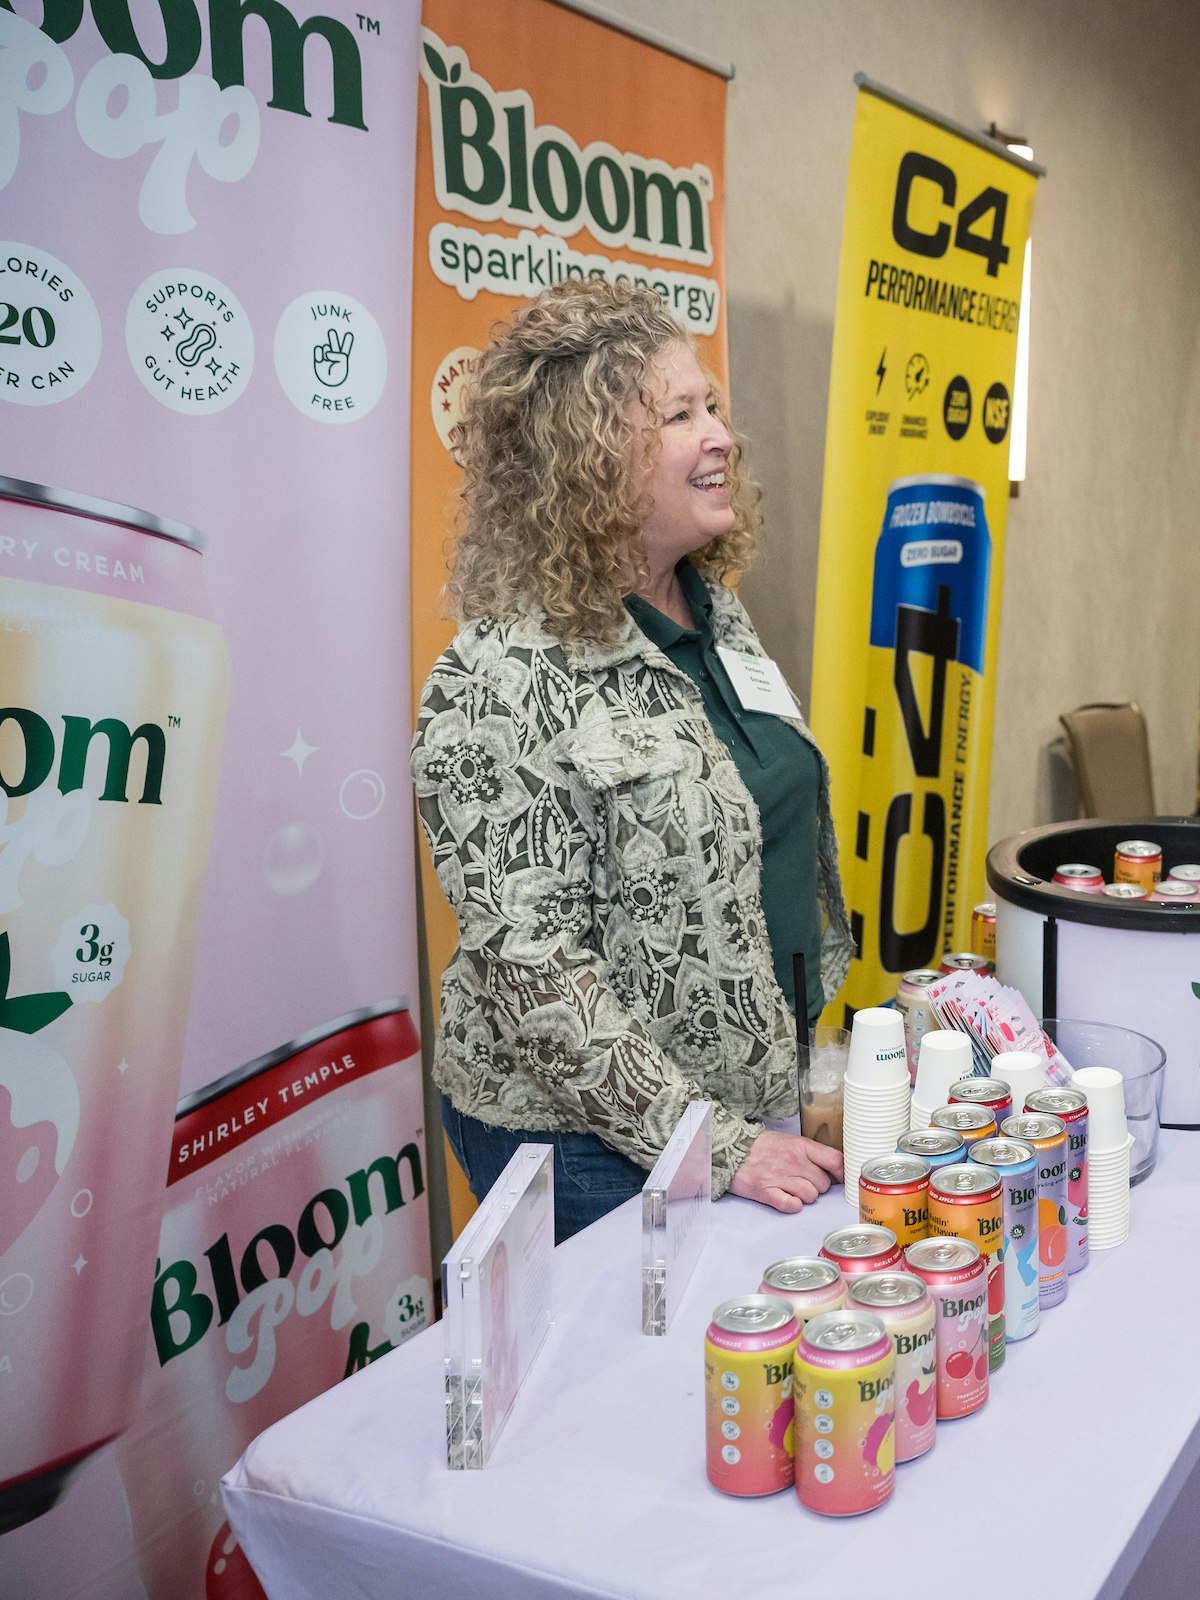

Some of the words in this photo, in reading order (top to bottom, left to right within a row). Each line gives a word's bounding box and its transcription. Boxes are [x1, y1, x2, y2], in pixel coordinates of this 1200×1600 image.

[439, 84, 707, 254] Bloom
[892, 152, 1011, 278] C4
[146, 283, 234, 323] SUPPORTS
[865, 259, 978, 323] PERFORMANCE
[0, 302, 56, 348] 20
[311, 304, 352, 322] JUNK
[31, 360, 75, 390] CAN
[145, 355, 175, 390] GUT
[181, 361, 241, 401] HEALTH
[311, 394, 355, 411] FREE
[53, 547, 146, 584] CREAM
[955, 672, 972, 764] ENERGY
[76, 923, 115, 967] 3g
[71, 971, 111, 983] SUGAR
[178, 1098, 270, 1164] SHIRLEY
[277, 1053, 356, 1104] TEMPLE
[866, 1184, 881, 1193] APPLE
[938, 1196, 954, 1204] APPLE
[150, 1143, 425, 1368] Bloom
[873, 1256, 893, 1268] SHIRLEY
[949, 1272, 971, 1282] SHIRLEY
[398, 1294, 425, 1323] 3g
[401, 1316, 427, 1338] SUGAR
[714, 1335, 742, 1349] LEMONADE
[761, 1333, 794, 1348] RASPBERRY
[806, 1351, 836, 1366] LEMONADE
